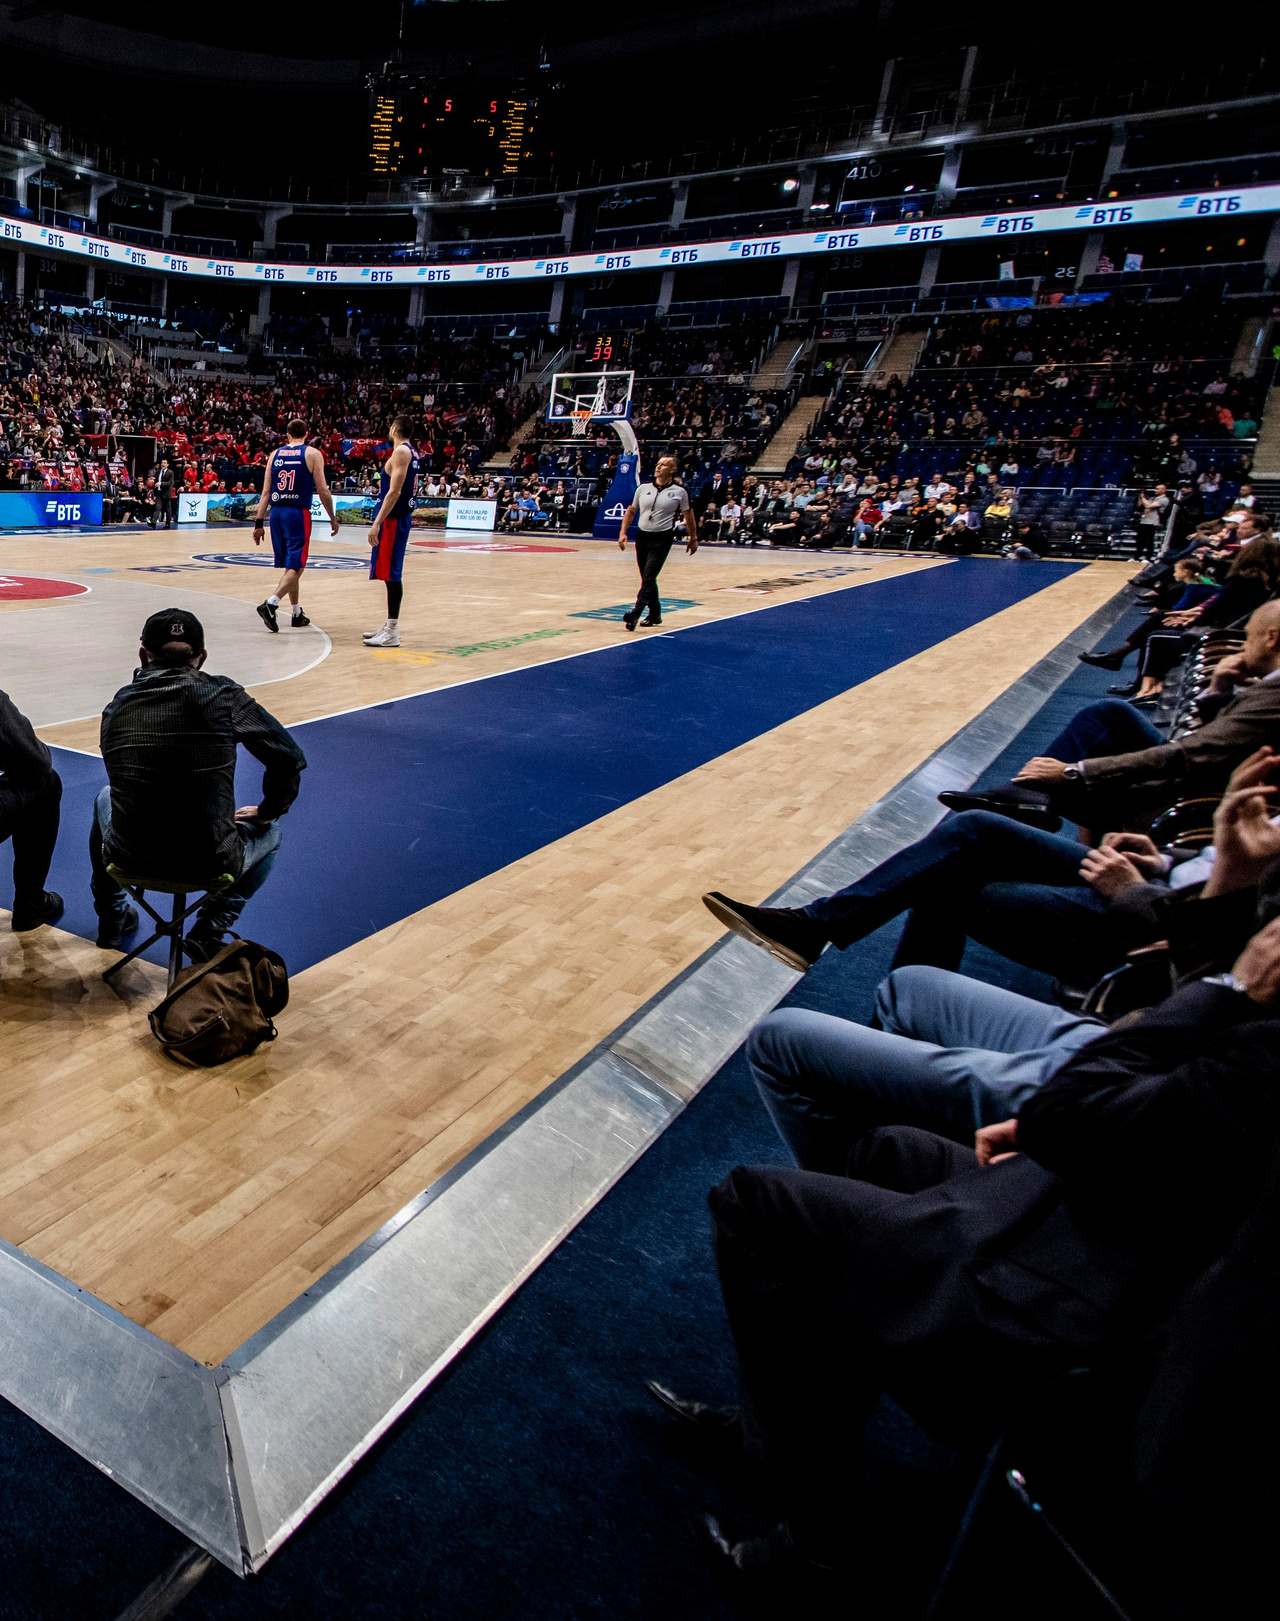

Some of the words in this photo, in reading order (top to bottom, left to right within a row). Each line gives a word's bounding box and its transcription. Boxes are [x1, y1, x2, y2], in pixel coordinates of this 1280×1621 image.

[445, 99, 452, 112] 5
[490, 101, 497, 113] 5
[846, 164, 882, 180] 410
[1197, 196, 1241, 214] ВТБ
[1093, 207, 1133, 224] ВТБ
[4, 224, 22, 239] ВТБ
[996, 217, 1035, 233] ВТБ
[909, 225, 943, 241] ВТБ
[48, 233, 65, 248] ВТБ
[827, 234, 859, 249] ВТБ
[131, 252, 146, 265] ВТБ
[606, 256, 630, 269] ВТБ
[671, 249, 698, 263] ВТБ
[829, 255, 863, 270] 318
[40, 258, 57, 274] 314
[170, 260, 188, 272] ВТБ
[215, 265, 234, 277] ВТБ
[486, 267, 509, 279] ВТБ
[545, 262, 568, 275] ВТБ
[264, 269, 284, 280] ВТБ
[316, 271, 337, 282] ВТБ
[371, 271, 392, 282] ВТБ
[427, 270, 450, 281] ВТБ
[592, 346, 613, 361] 39
[277, 469, 295, 491] 31
[57, 505, 81, 521] ВТБ
